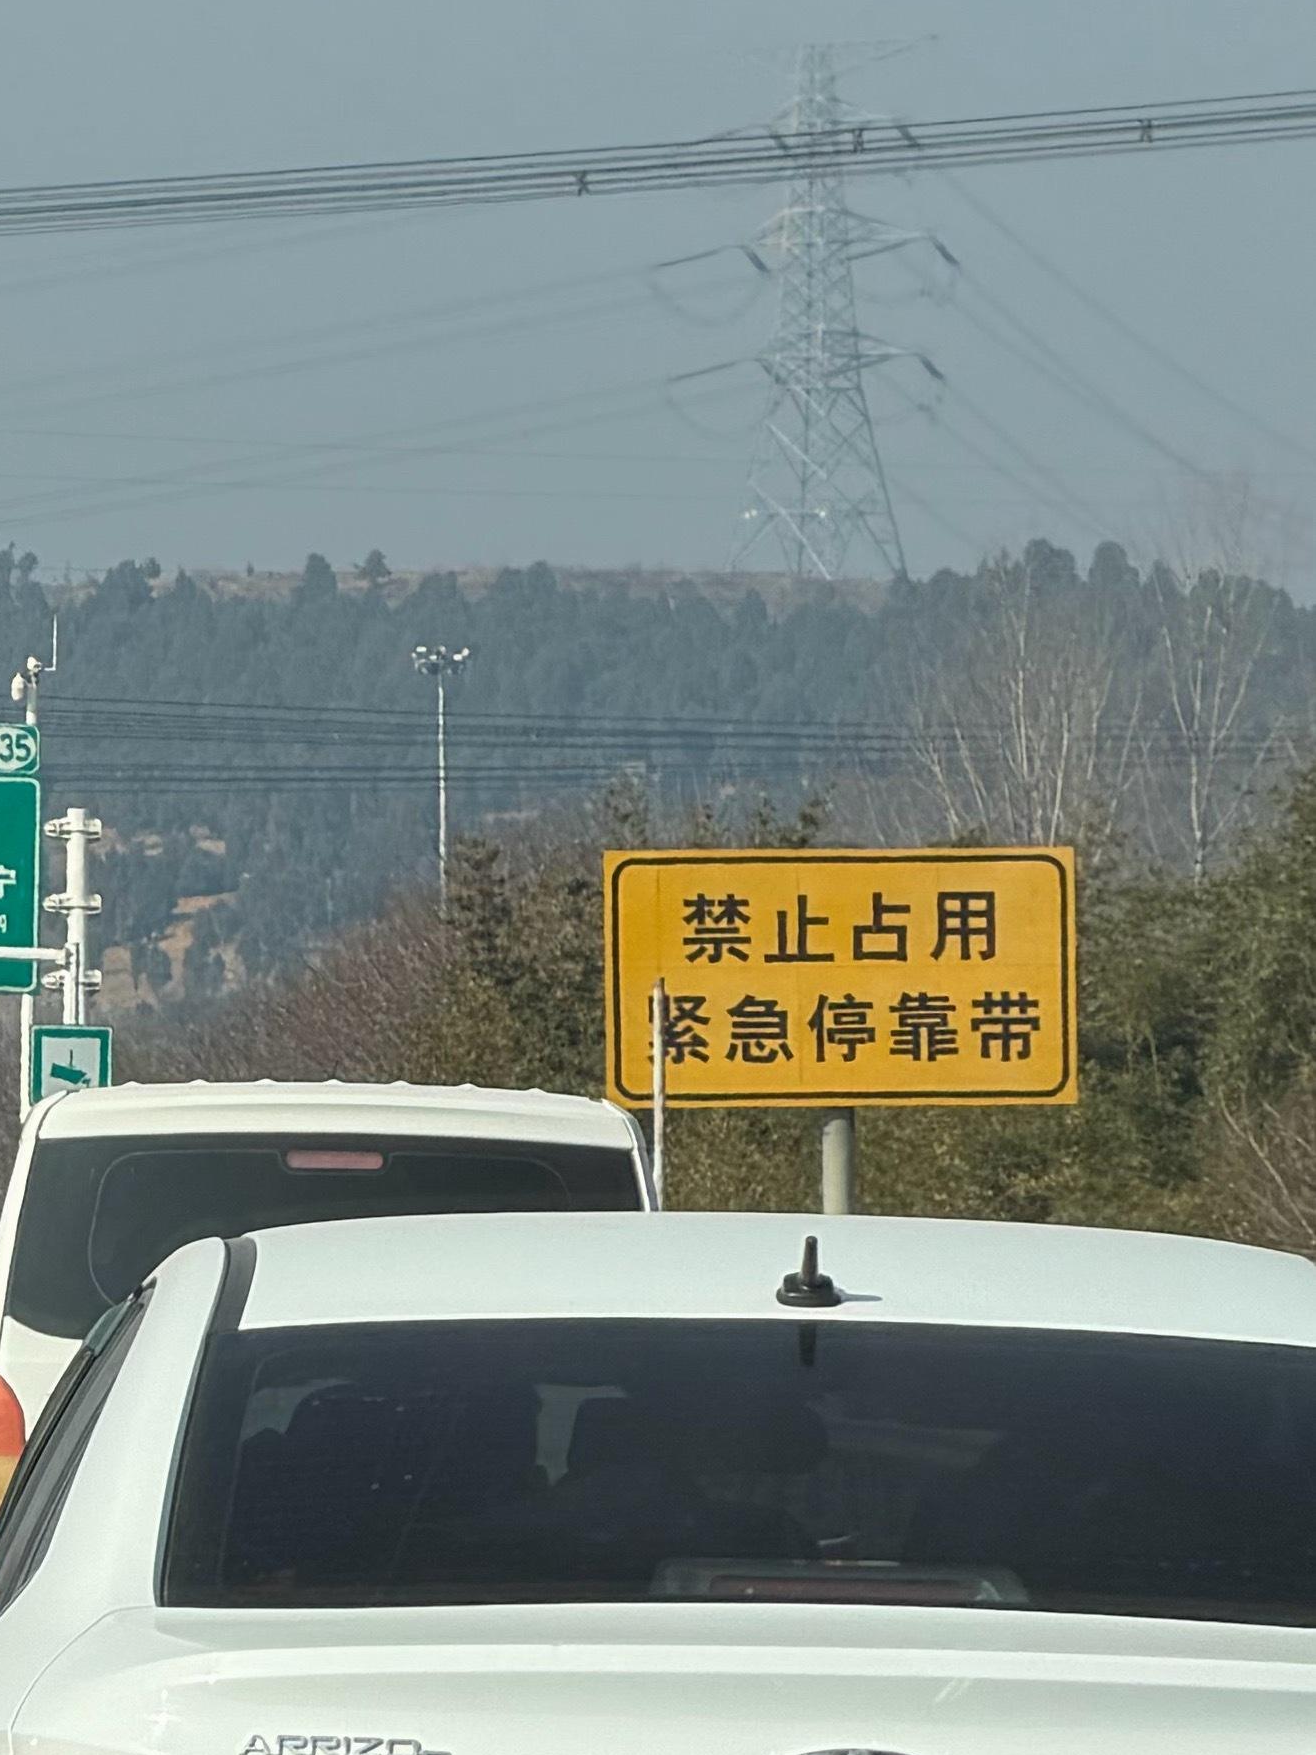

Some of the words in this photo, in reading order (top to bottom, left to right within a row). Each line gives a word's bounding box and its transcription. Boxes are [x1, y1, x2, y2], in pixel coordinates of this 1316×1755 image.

[680, 889, 998, 965] 禁止占用
[646, 989, 1042, 1066] 紧急停靠带
